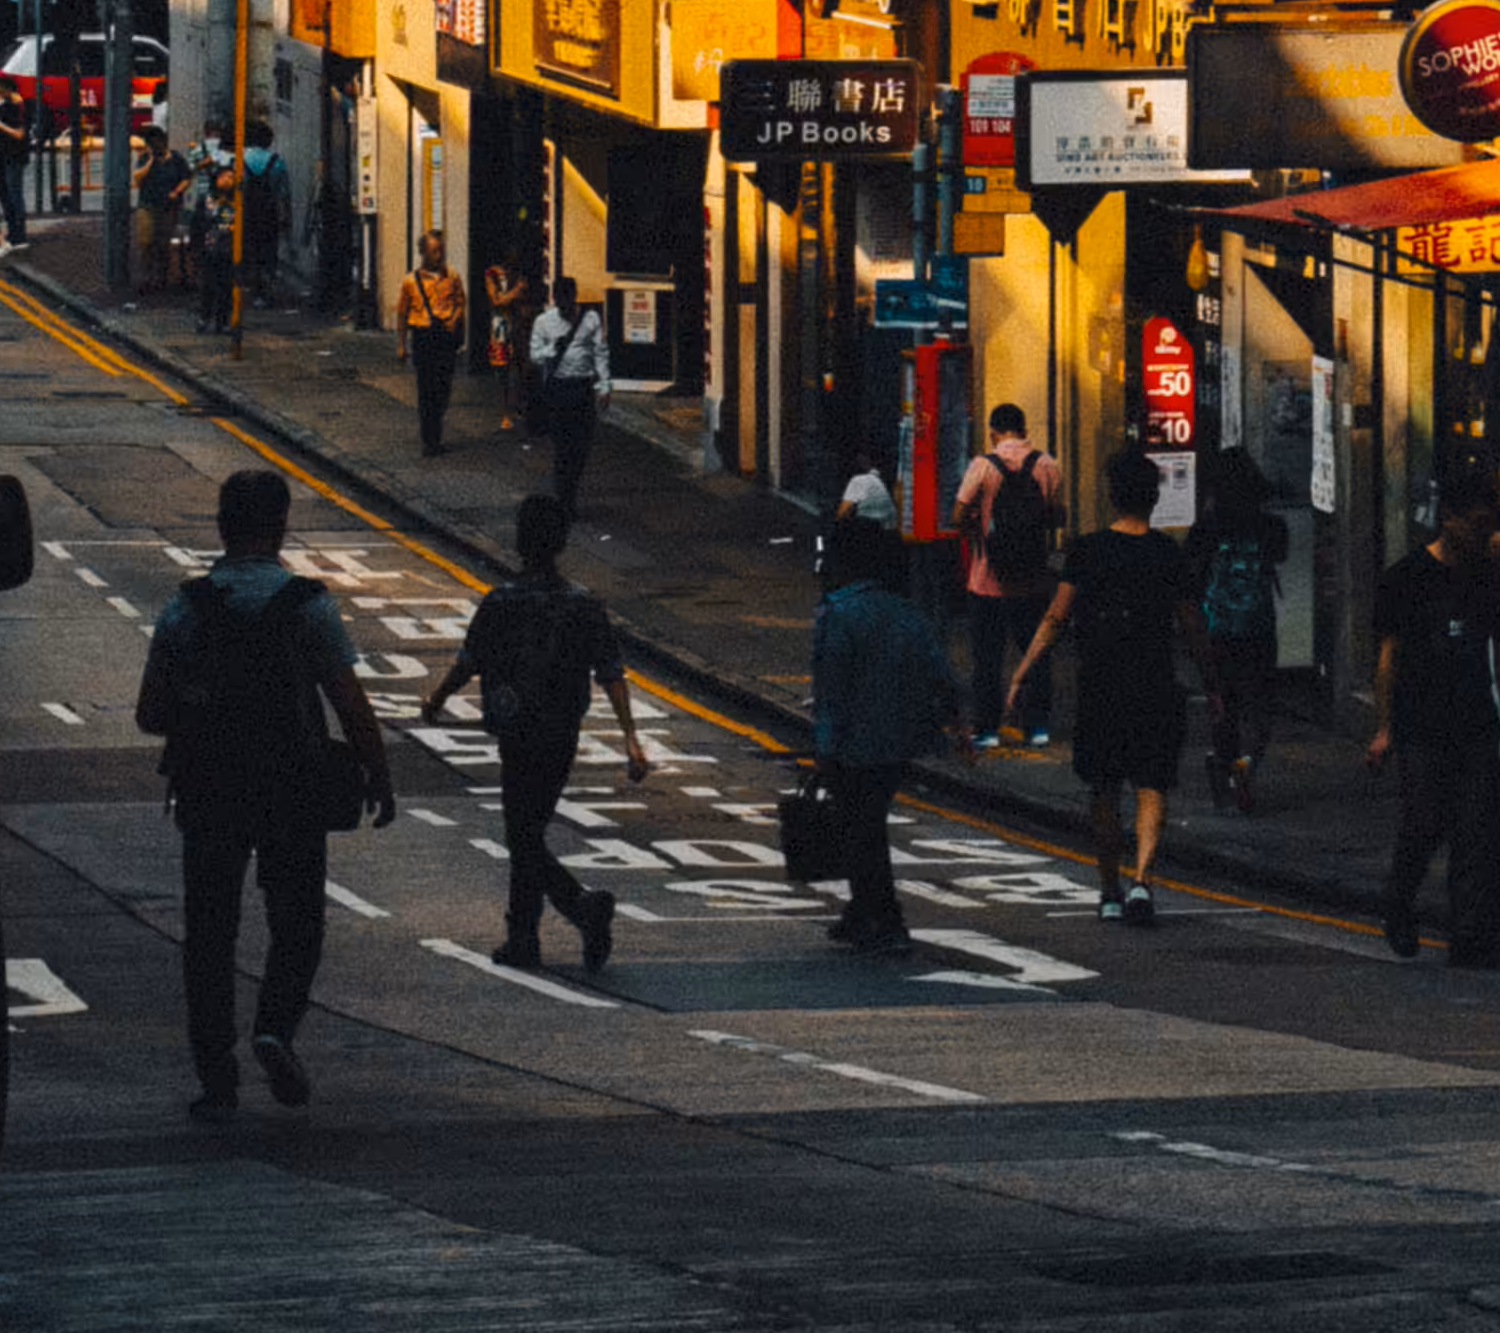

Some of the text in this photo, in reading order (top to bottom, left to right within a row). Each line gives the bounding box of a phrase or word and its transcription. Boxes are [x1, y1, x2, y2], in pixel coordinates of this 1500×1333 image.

[756, 120, 892, 144] JP Books
[1160, 371, 1191, 396] 50
[1161, 418, 1191, 443] 10
